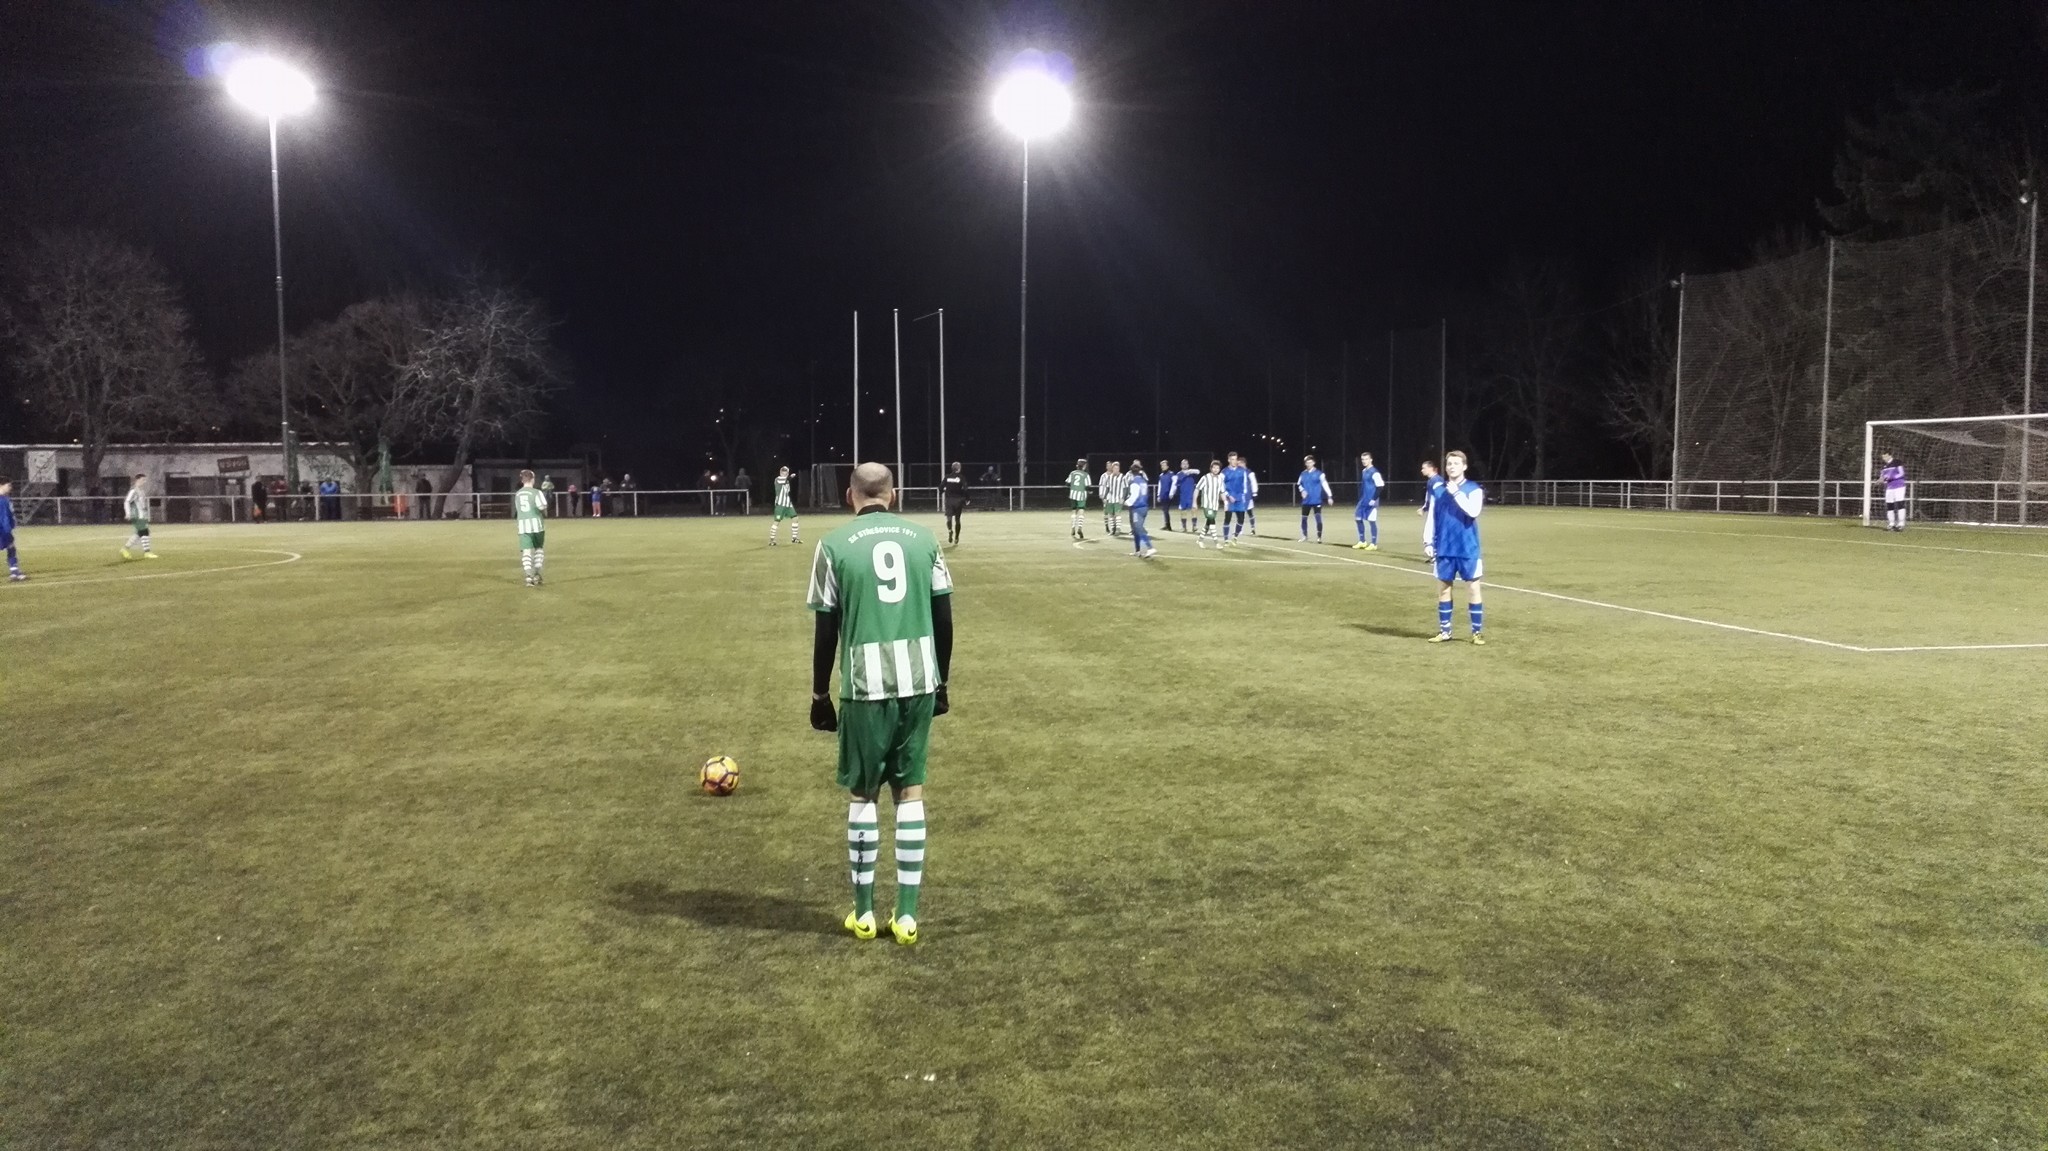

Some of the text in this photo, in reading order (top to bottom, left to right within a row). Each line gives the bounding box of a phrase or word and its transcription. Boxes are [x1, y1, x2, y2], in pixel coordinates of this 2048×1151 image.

[1073, 475, 1081, 486] 2
[519, 495, 530, 512] 5
[873, 540, 907, 603] 9
